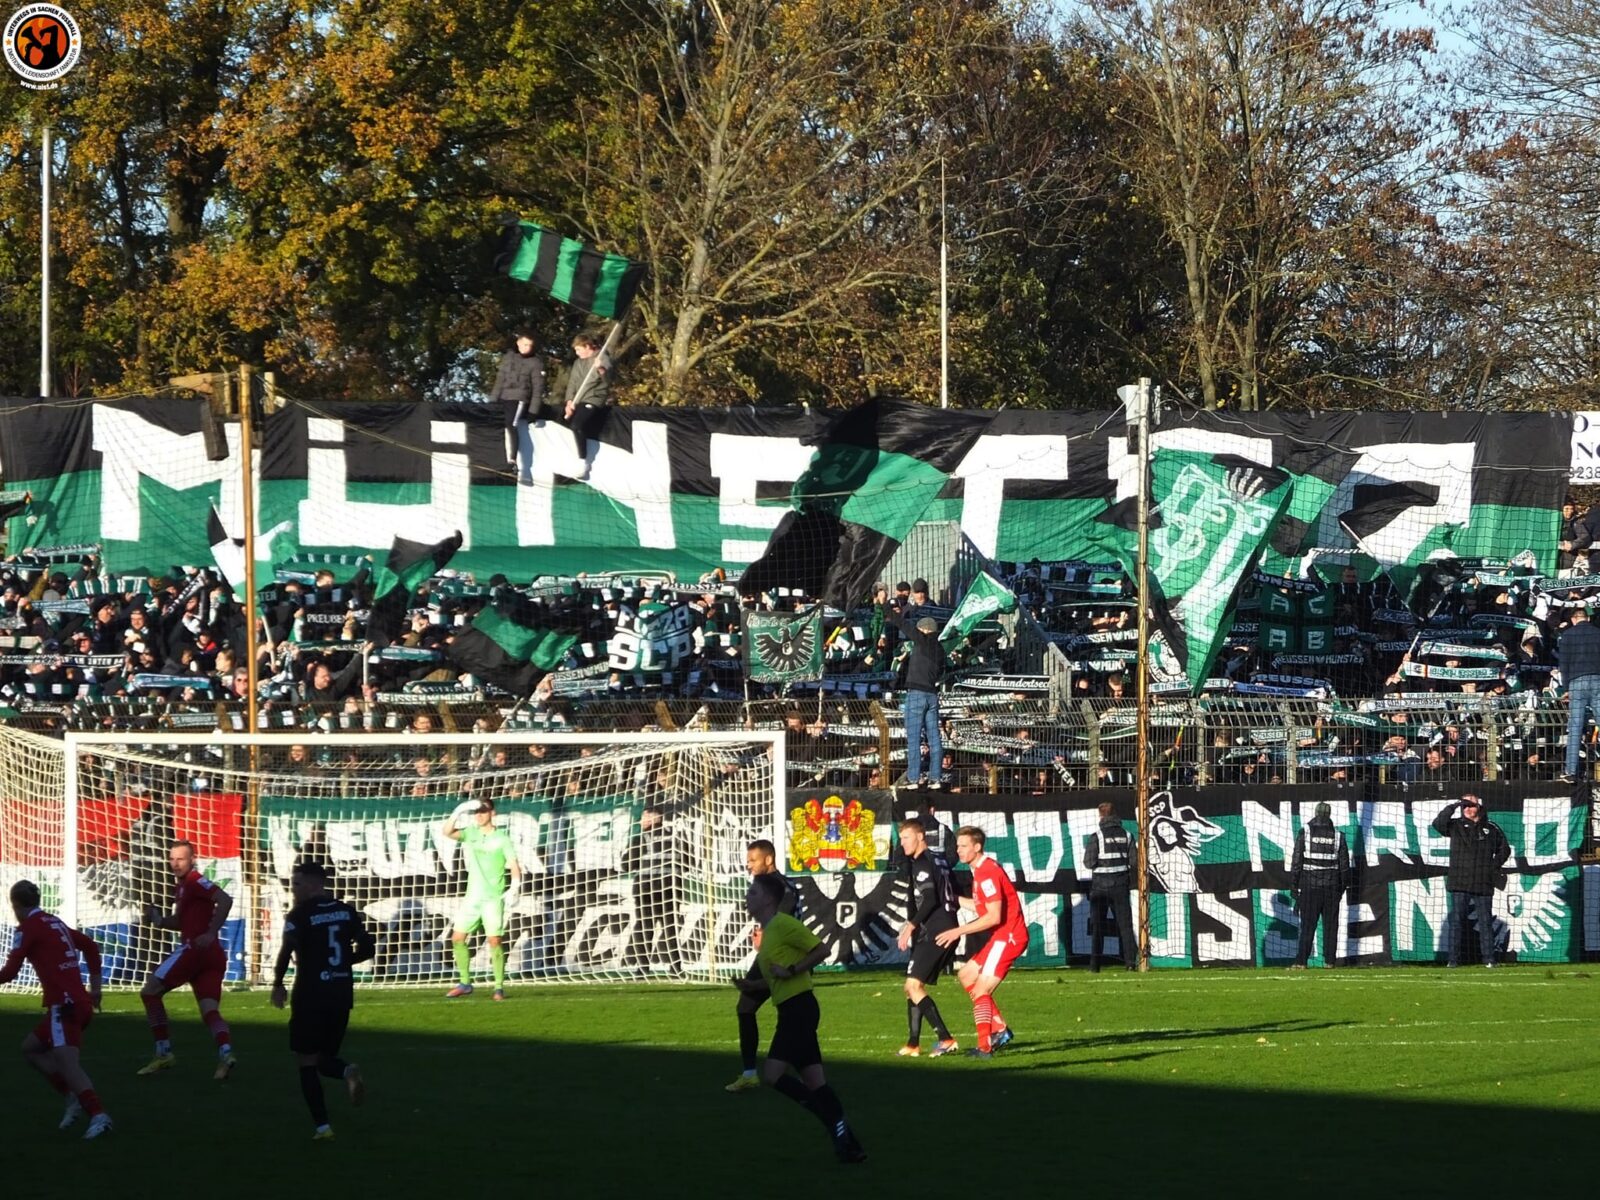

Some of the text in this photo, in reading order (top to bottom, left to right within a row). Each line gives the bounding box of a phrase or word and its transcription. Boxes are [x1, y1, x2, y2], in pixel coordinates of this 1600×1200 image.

[606, 631, 691, 670] SCP
[1066, 631, 1113, 652] PREUSSEN
[1272, 655, 1315, 669] PREUSSEN
[1149, 801, 1166, 817] SCP
[840, 904, 854, 924] P
[328, 924, 342, 966] 5
